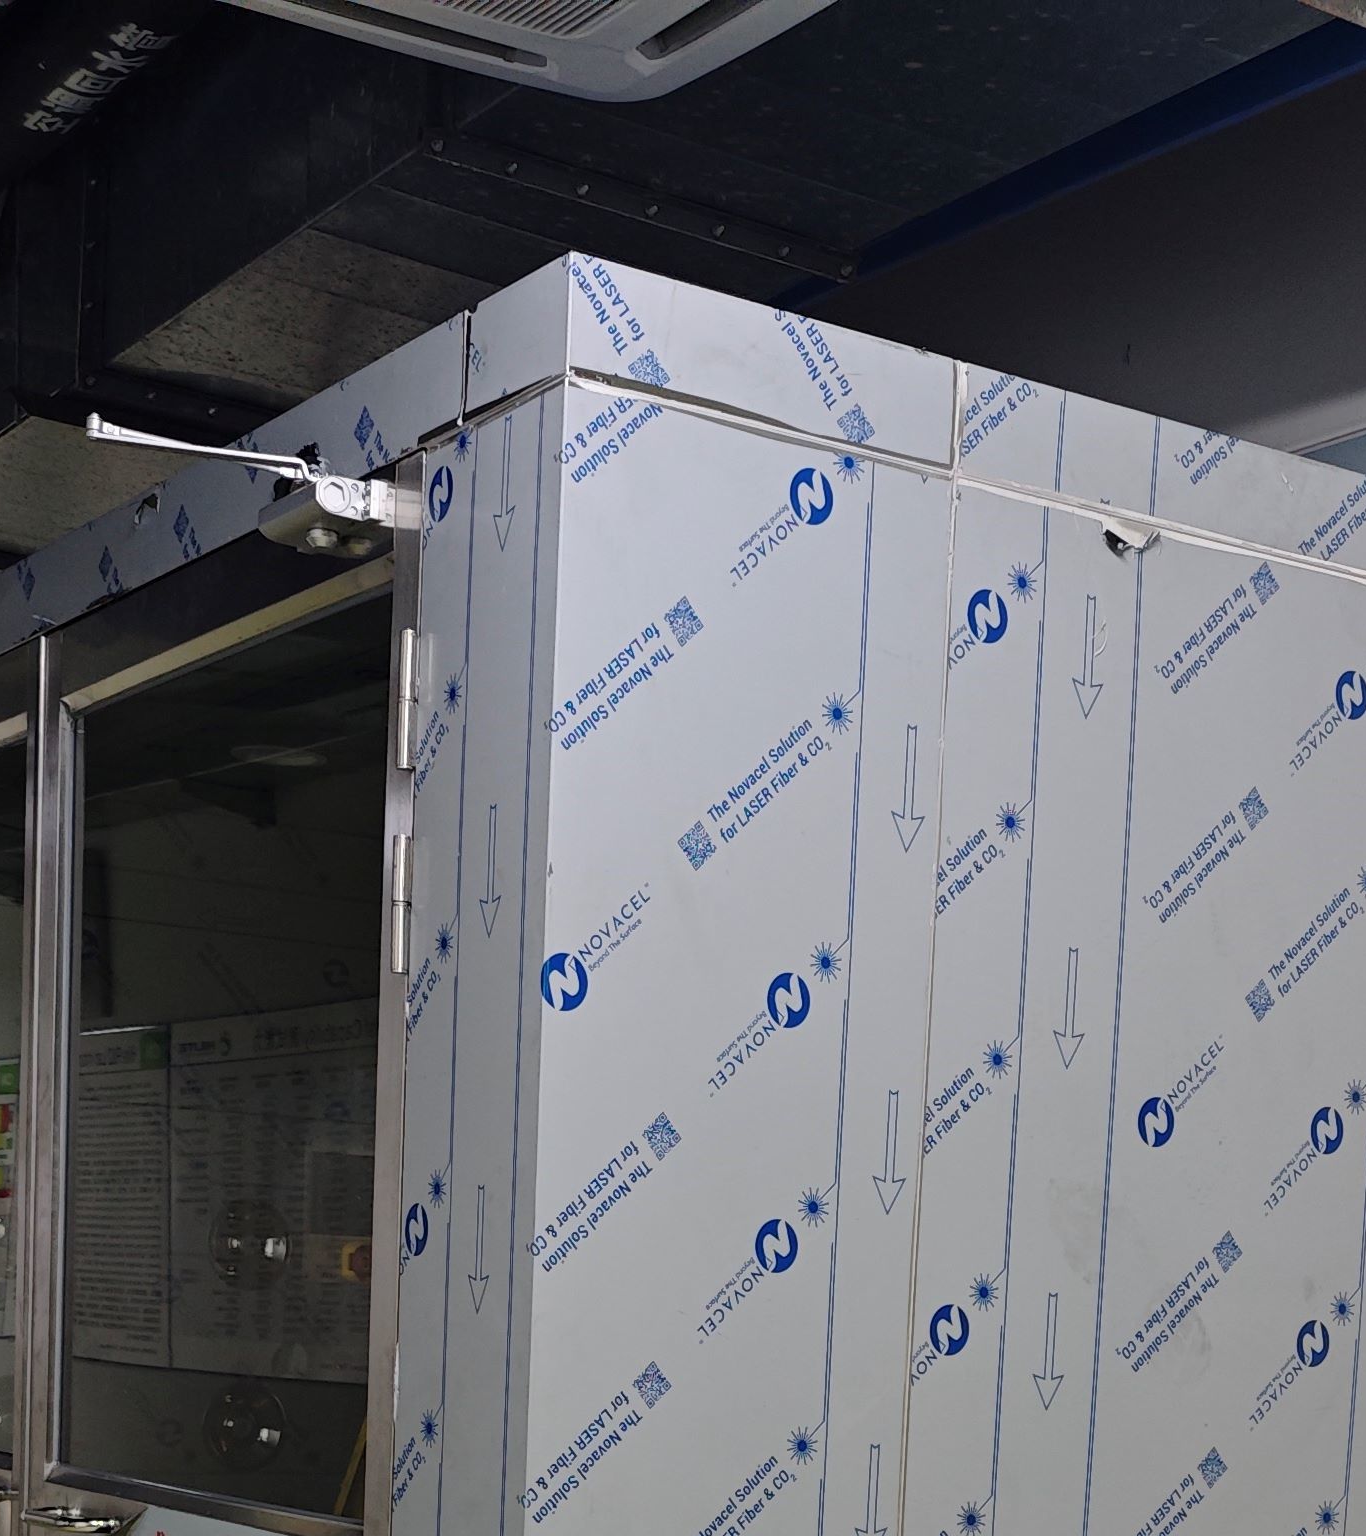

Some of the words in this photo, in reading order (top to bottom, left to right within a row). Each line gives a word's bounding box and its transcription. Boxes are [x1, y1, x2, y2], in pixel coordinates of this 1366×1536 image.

[23, 22, 179, 135] 空调回水管
[730, 517, 799, 580] NOVACEL
[1232, 584, 1247, 602] for
[1238, 603, 1257, 623] The
[641, 622, 660, 644] for
[1203, 597, 1234, 633] LASER
[603, 638, 644, 679] LASER
[650, 645, 674, 667] The
[1174, 651, 1183, 664] &
[1182, 627, 1206, 655] Fiber
[1205, 619, 1241, 661] Novacel
[576, 672, 607, 705] Fiber
[606, 663, 653, 712] Novacel
[1171, 654, 1207, 694] Solution
[561, 705, 609, 750] Solution
[564, 700, 577, 715] &
[1289, 711, 1343, 771] NOVACEL
[707, 800, 731, 822] The
[727, 756, 771, 804] Novacel
[768, 720, 813, 763] Solution
[720, 822, 738, 843] for
[736, 787, 774, 827] LASER
[770, 762, 798, 793] Fiber
[797, 752, 809, 767] &
[578, 890, 651, 962] NOVACEL
[1268, 960, 1286, 980] The
[1284, 921, 1318, 963] Novacel
[1316, 888, 1350, 927] Solution
[1277, 979, 1292, 998] for
[1289, 948, 1319, 983] LASER
[1317, 925, 1339, 953] Fiber
[1338, 916, 1347, 929] &
[708, 1020, 776, 1090] NOVACEL
[1167, 1041, 1224, 1104] NOVACEL
[1263, 1149, 1317, 1210] NOVACEL
[1195, 1257, 1209, 1275] for
[1200, 1273, 1219, 1293] The
[697, 1267, 764, 1336] NOVACEL
[1165, 1272, 1196, 1308] LASER
[1144, 1304, 1168, 1333] Fiber
[1167, 1291, 1203, 1335] Novacel
[1131, 1330, 1169, 1372] Solution
[1135, 1330, 1145, 1343] &
[1249, 1362, 1303, 1424] NOVACEL
[735, 1456, 778, 1502] Solution
[736, 1498, 765, 1530] Fiber
[763, 1488, 775, 1501] &
